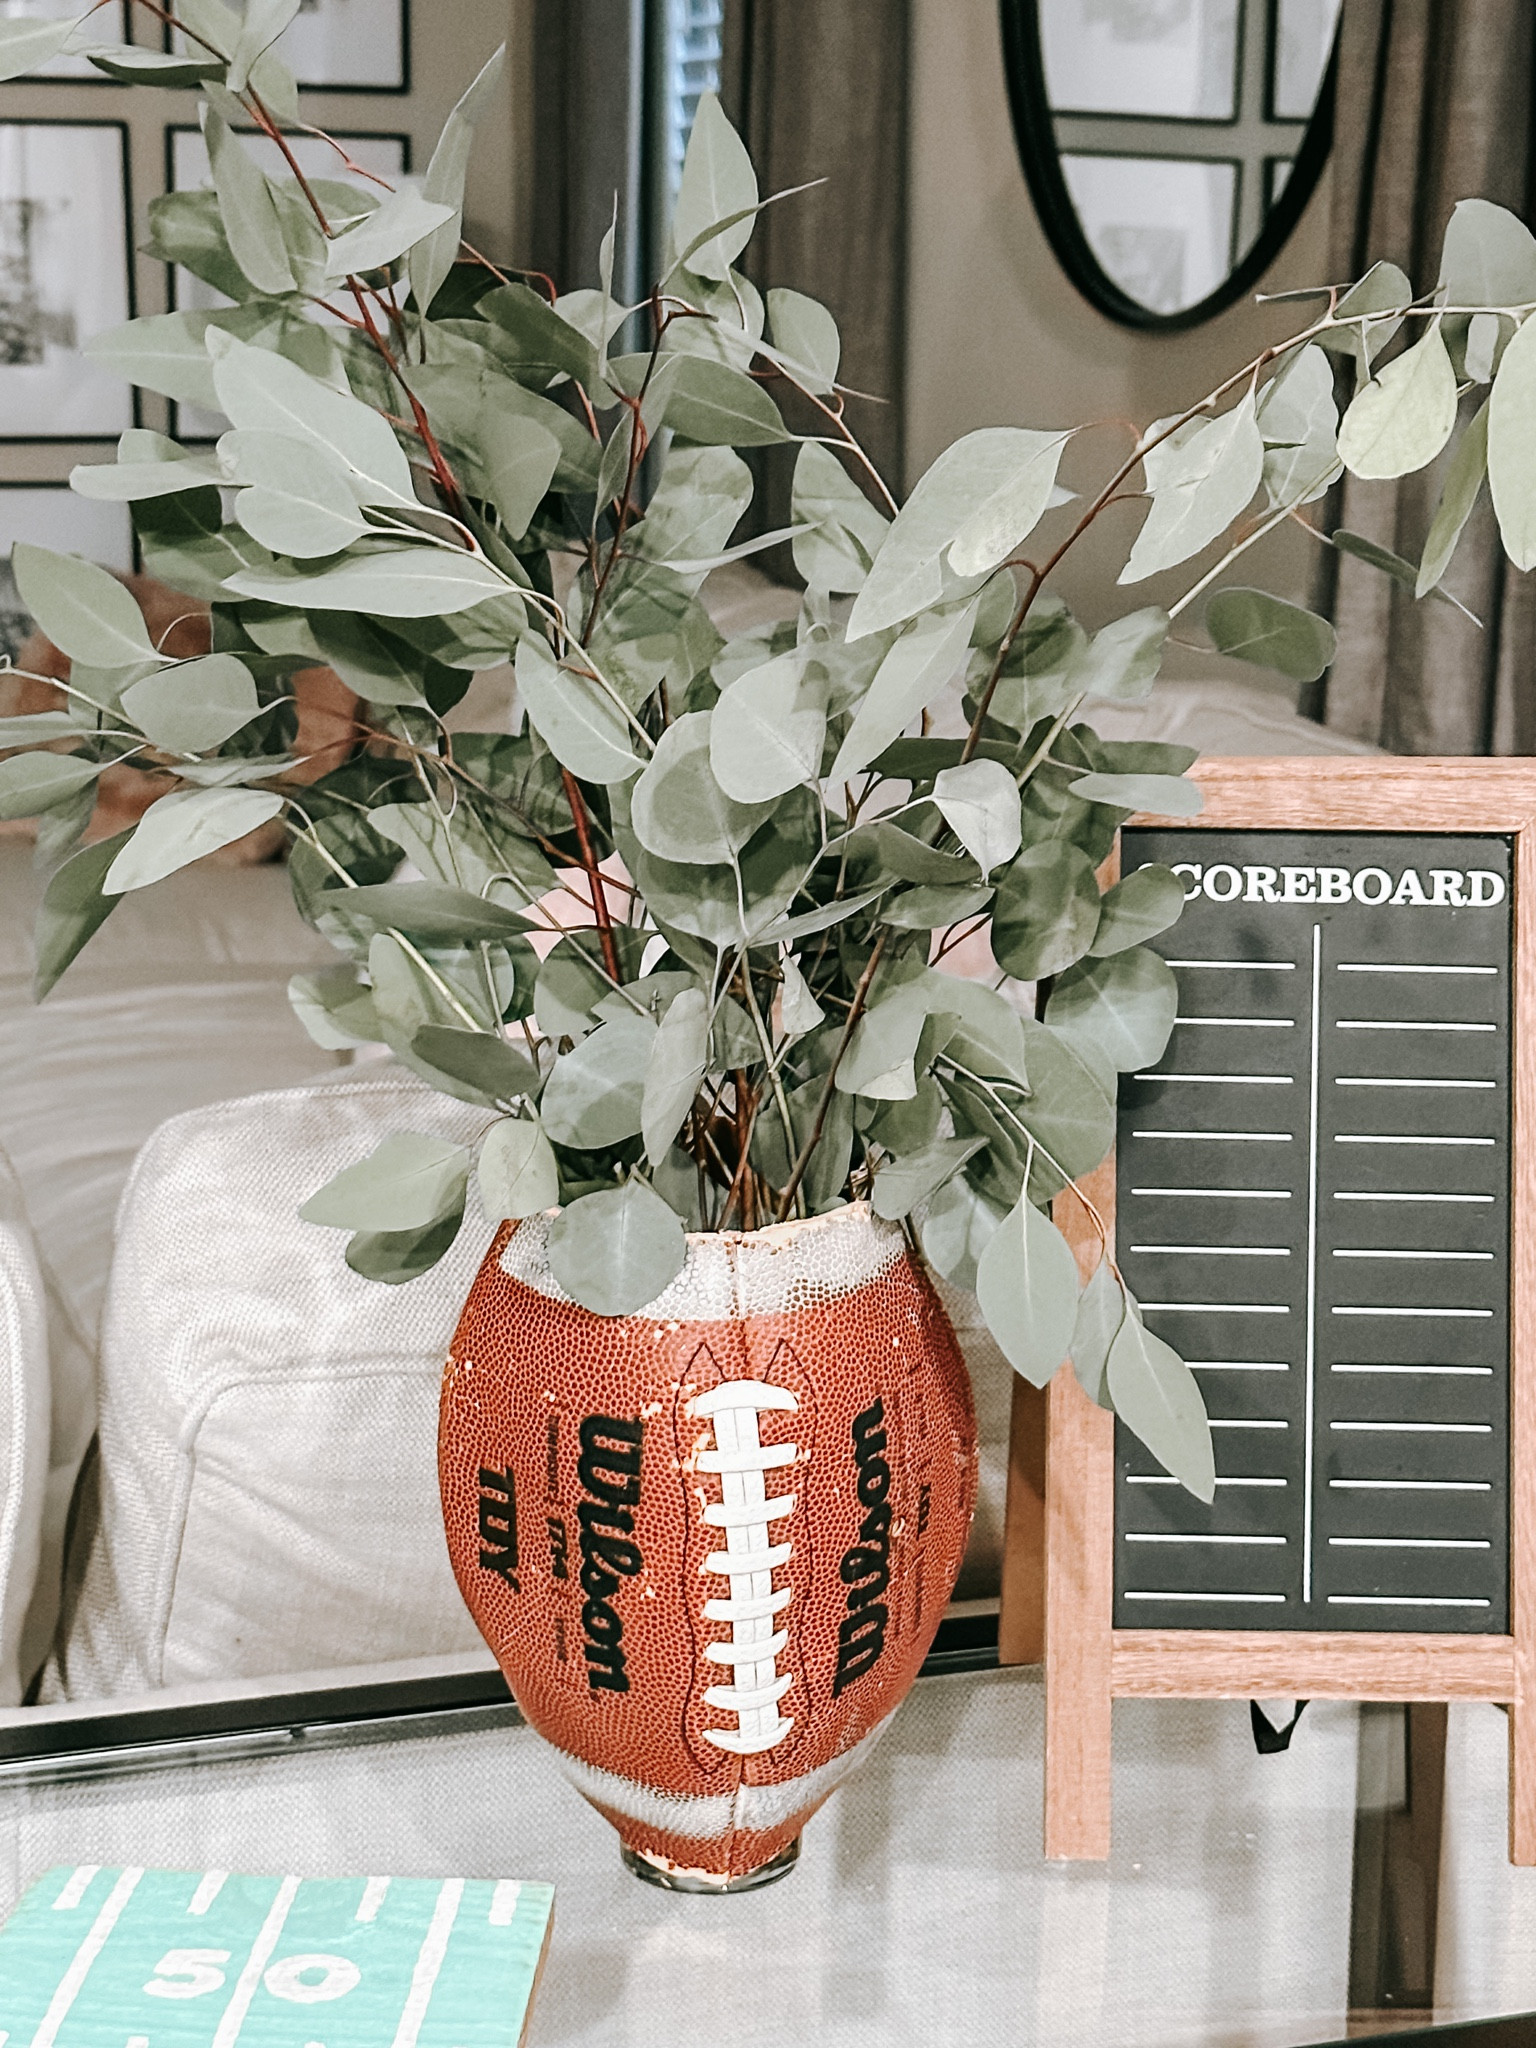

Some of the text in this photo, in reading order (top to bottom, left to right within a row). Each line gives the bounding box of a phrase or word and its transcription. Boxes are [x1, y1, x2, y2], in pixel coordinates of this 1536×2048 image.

[1138, 862, 1505, 907] COREBOARD
[479, 1464, 520, 1594] TDY
[577, 1413, 643, 1693] Wilson
[832, 1395, 893, 1699] Wilson
[142, 1948, 362, 2003] 50
